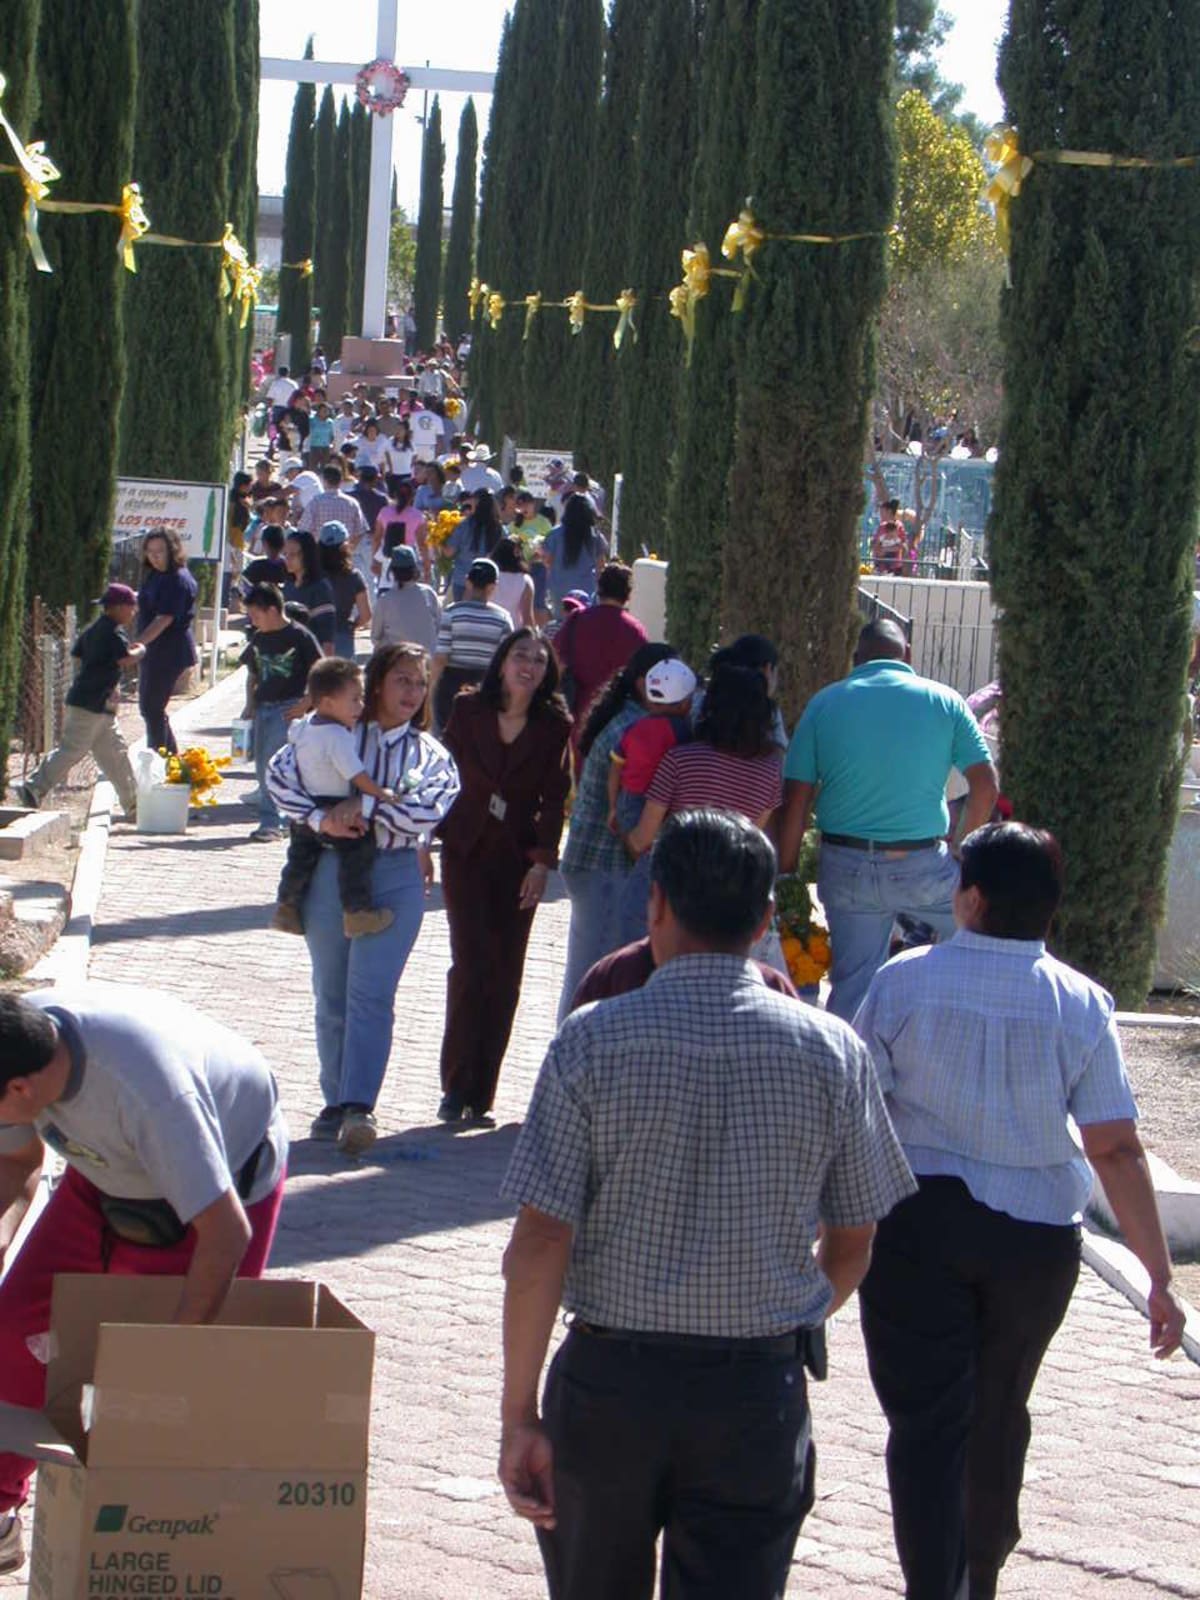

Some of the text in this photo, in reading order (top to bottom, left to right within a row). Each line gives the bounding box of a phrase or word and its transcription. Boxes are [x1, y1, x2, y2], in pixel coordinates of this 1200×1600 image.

[118, 514, 142, 526] LOS
[277, 1482, 355, 1506] 20310
[127, 1513, 216, 1539] Genpak
[89, 1552, 170, 1572] LARGE
[88, 1575, 222, 1594] HINGED LID
